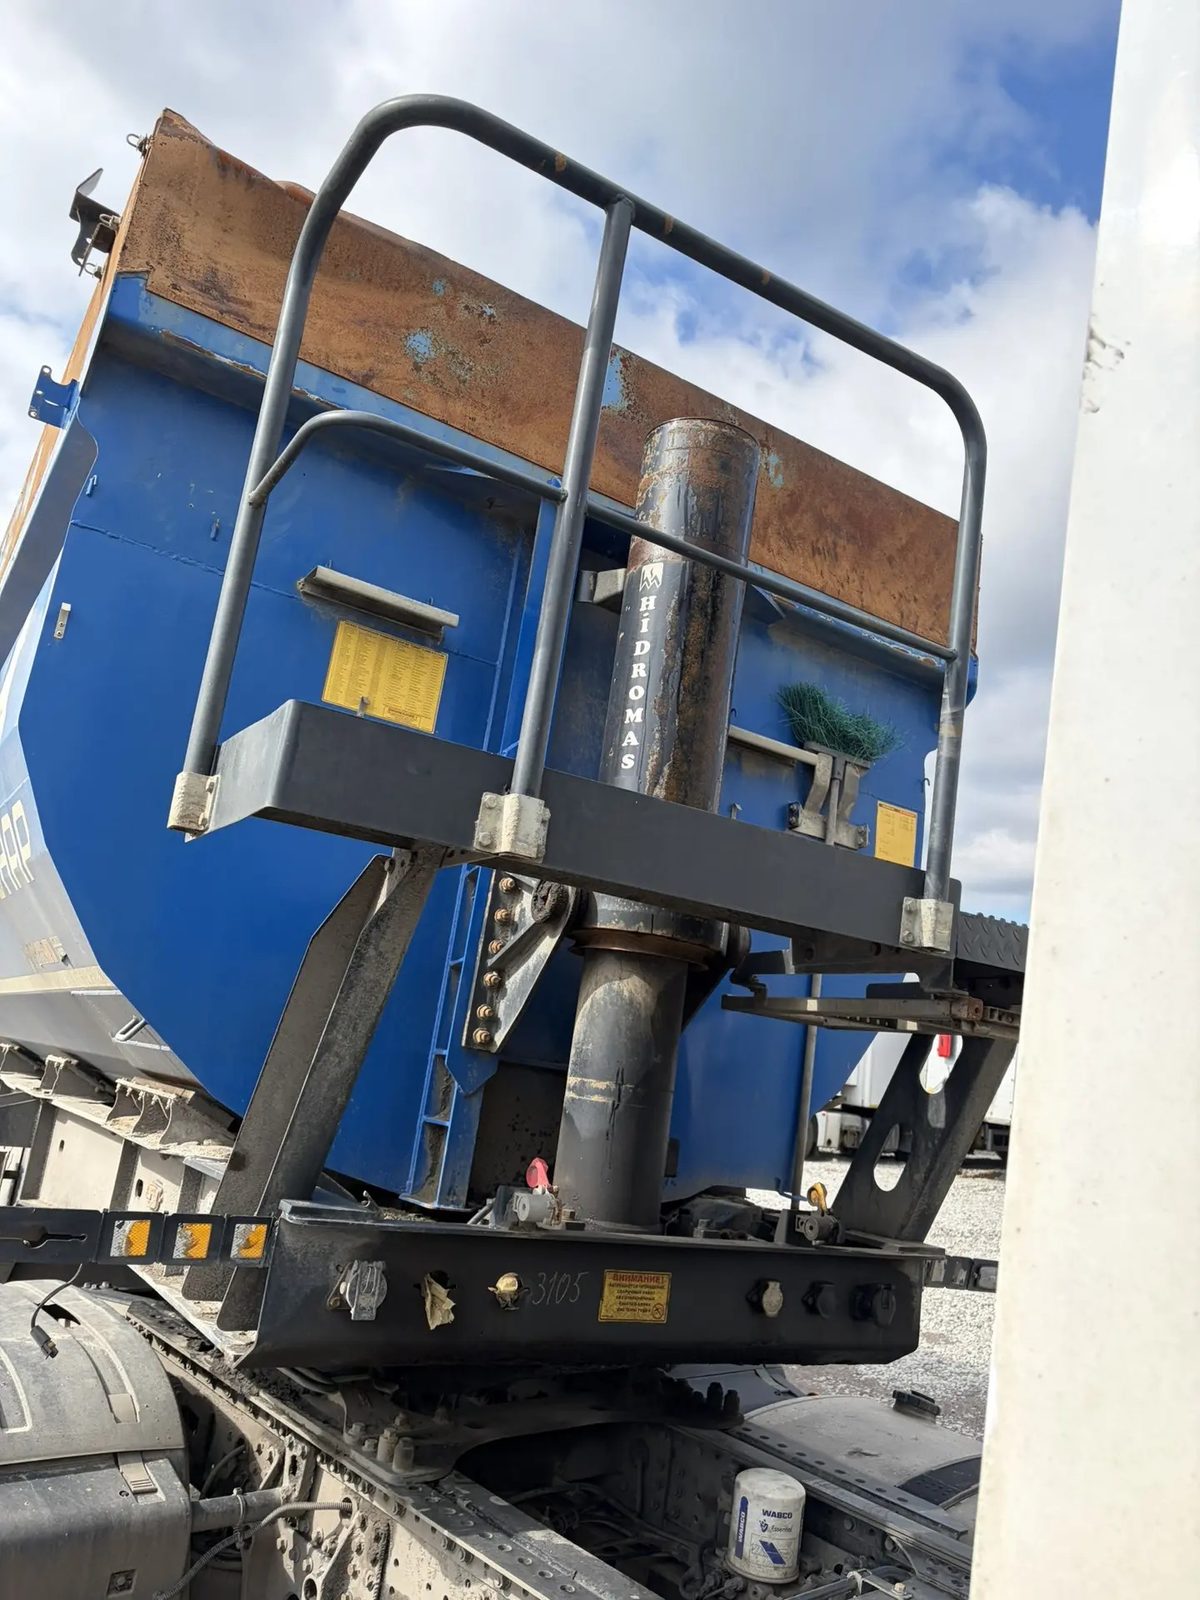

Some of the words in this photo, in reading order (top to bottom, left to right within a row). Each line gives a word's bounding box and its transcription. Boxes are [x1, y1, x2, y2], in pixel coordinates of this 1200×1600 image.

[532, 1271, 589, 1305] 3105
[613, 1273, 664, 1285] ВНИМАНИЕ!
[762, 1508, 793, 1519] WABCO
[738, 1511, 746, 1542] WABCO
